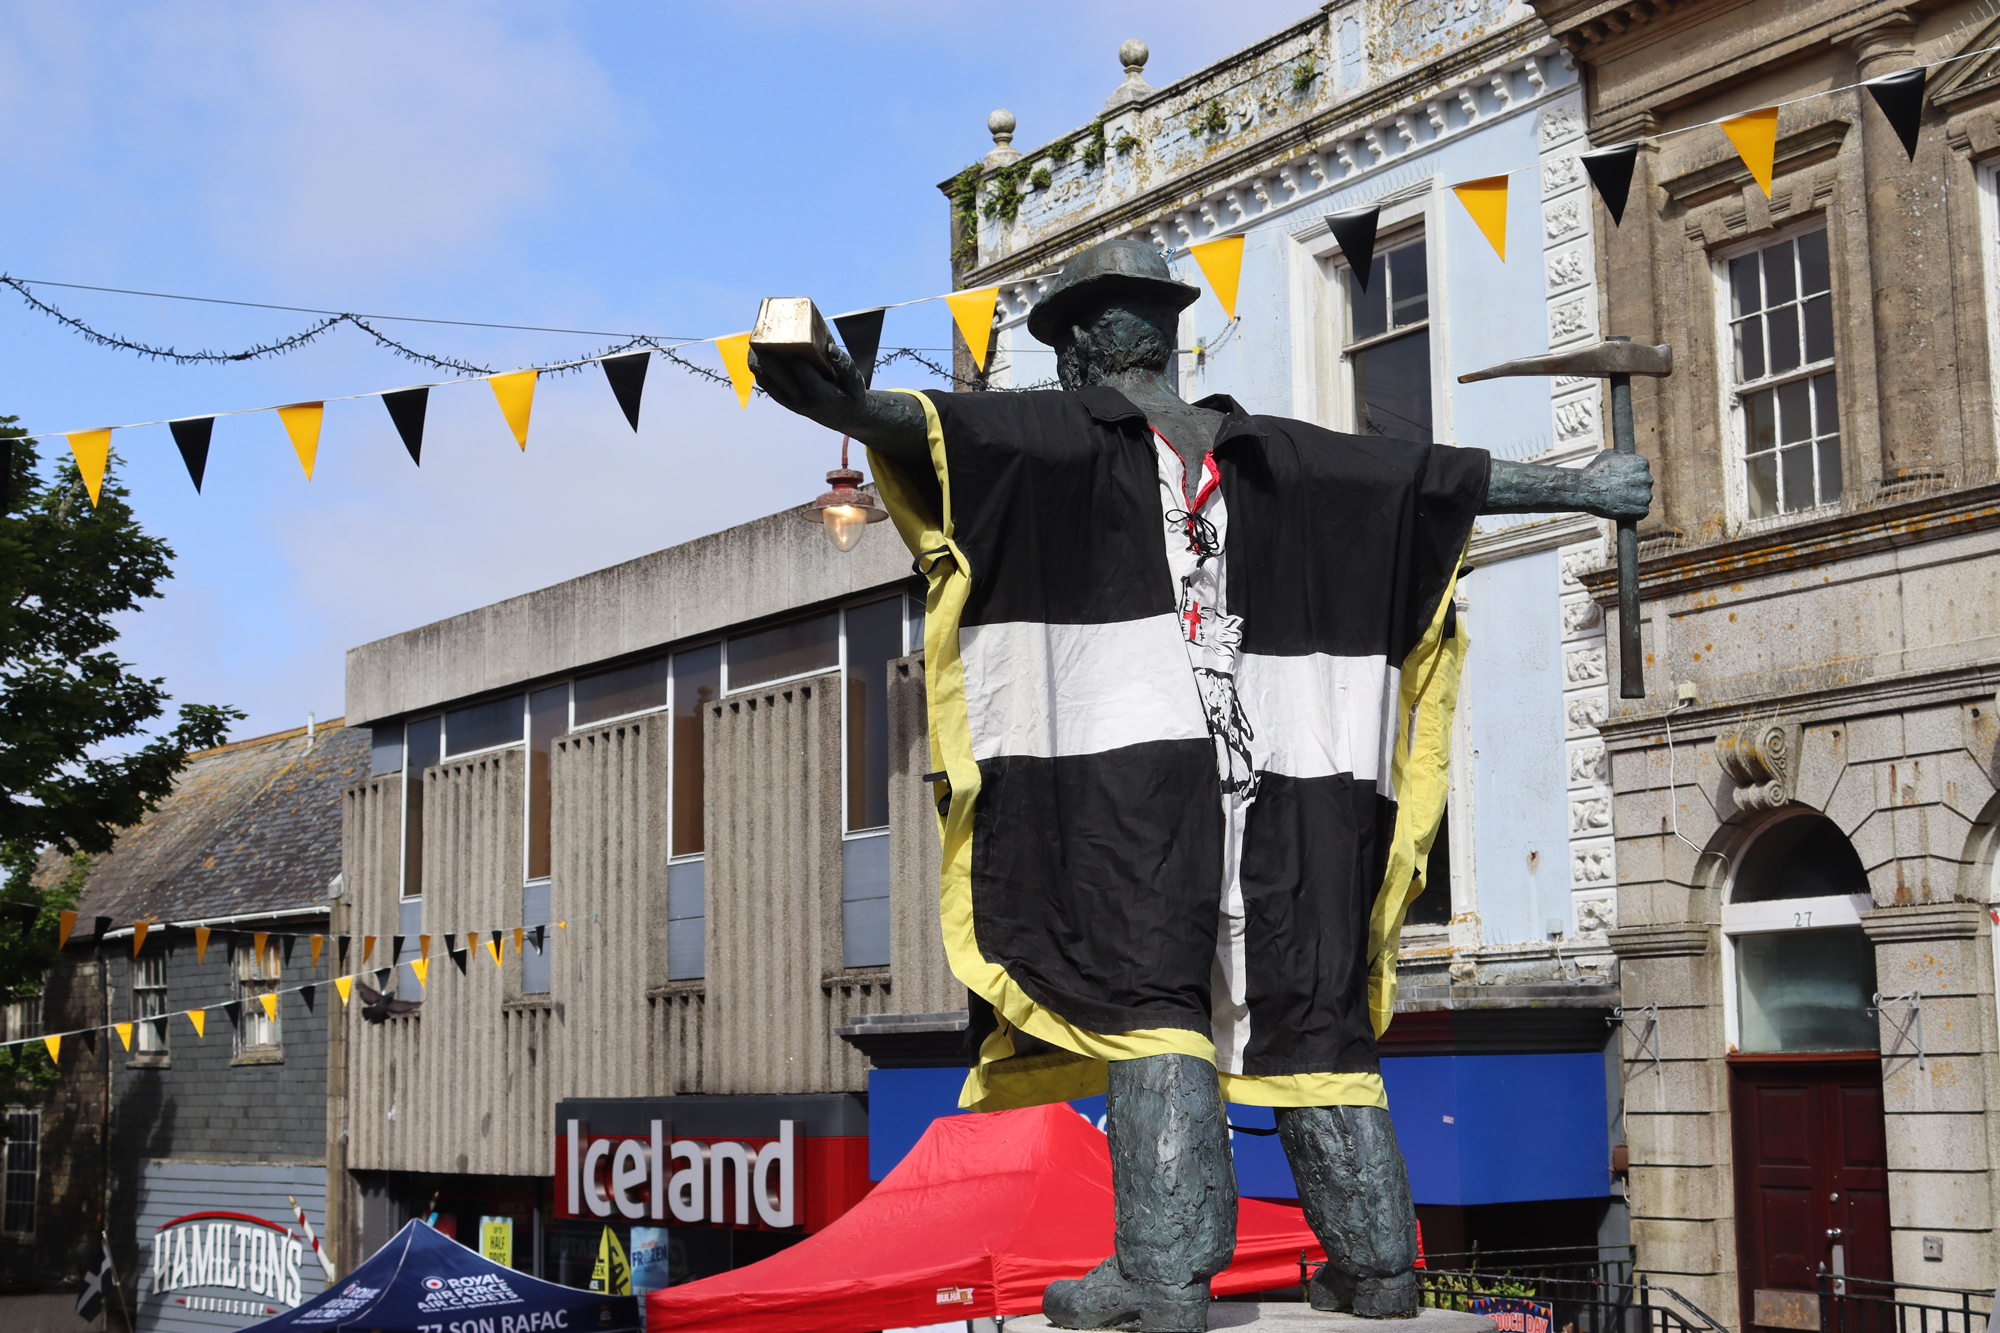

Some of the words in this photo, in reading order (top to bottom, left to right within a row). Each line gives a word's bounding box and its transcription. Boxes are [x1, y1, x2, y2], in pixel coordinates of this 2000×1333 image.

[1794, 911, 1812, 927] 27
[567, 1119, 795, 1228] Iceland
[490, 1236, 505, 1250] HALF
[632, 1245, 667, 1267] FROZEN
[152, 1223, 303, 1309] HAMILTON'S
[447, 1273, 505, 1289] ROYAL
[417, 1299, 448, 1309] AIR
[449, 1291, 518, 1305] CADETS
[425, 1290, 456, 1301] AIR
[454, 1282, 511, 1298] FORCE
[936, 1288, 975, 1303] BULHAK
[449, 1317, 494, 1333] SON
[501, 1309, 568, 1333] RAFAC
[1525, 1314, 1549, 1333] DAY
